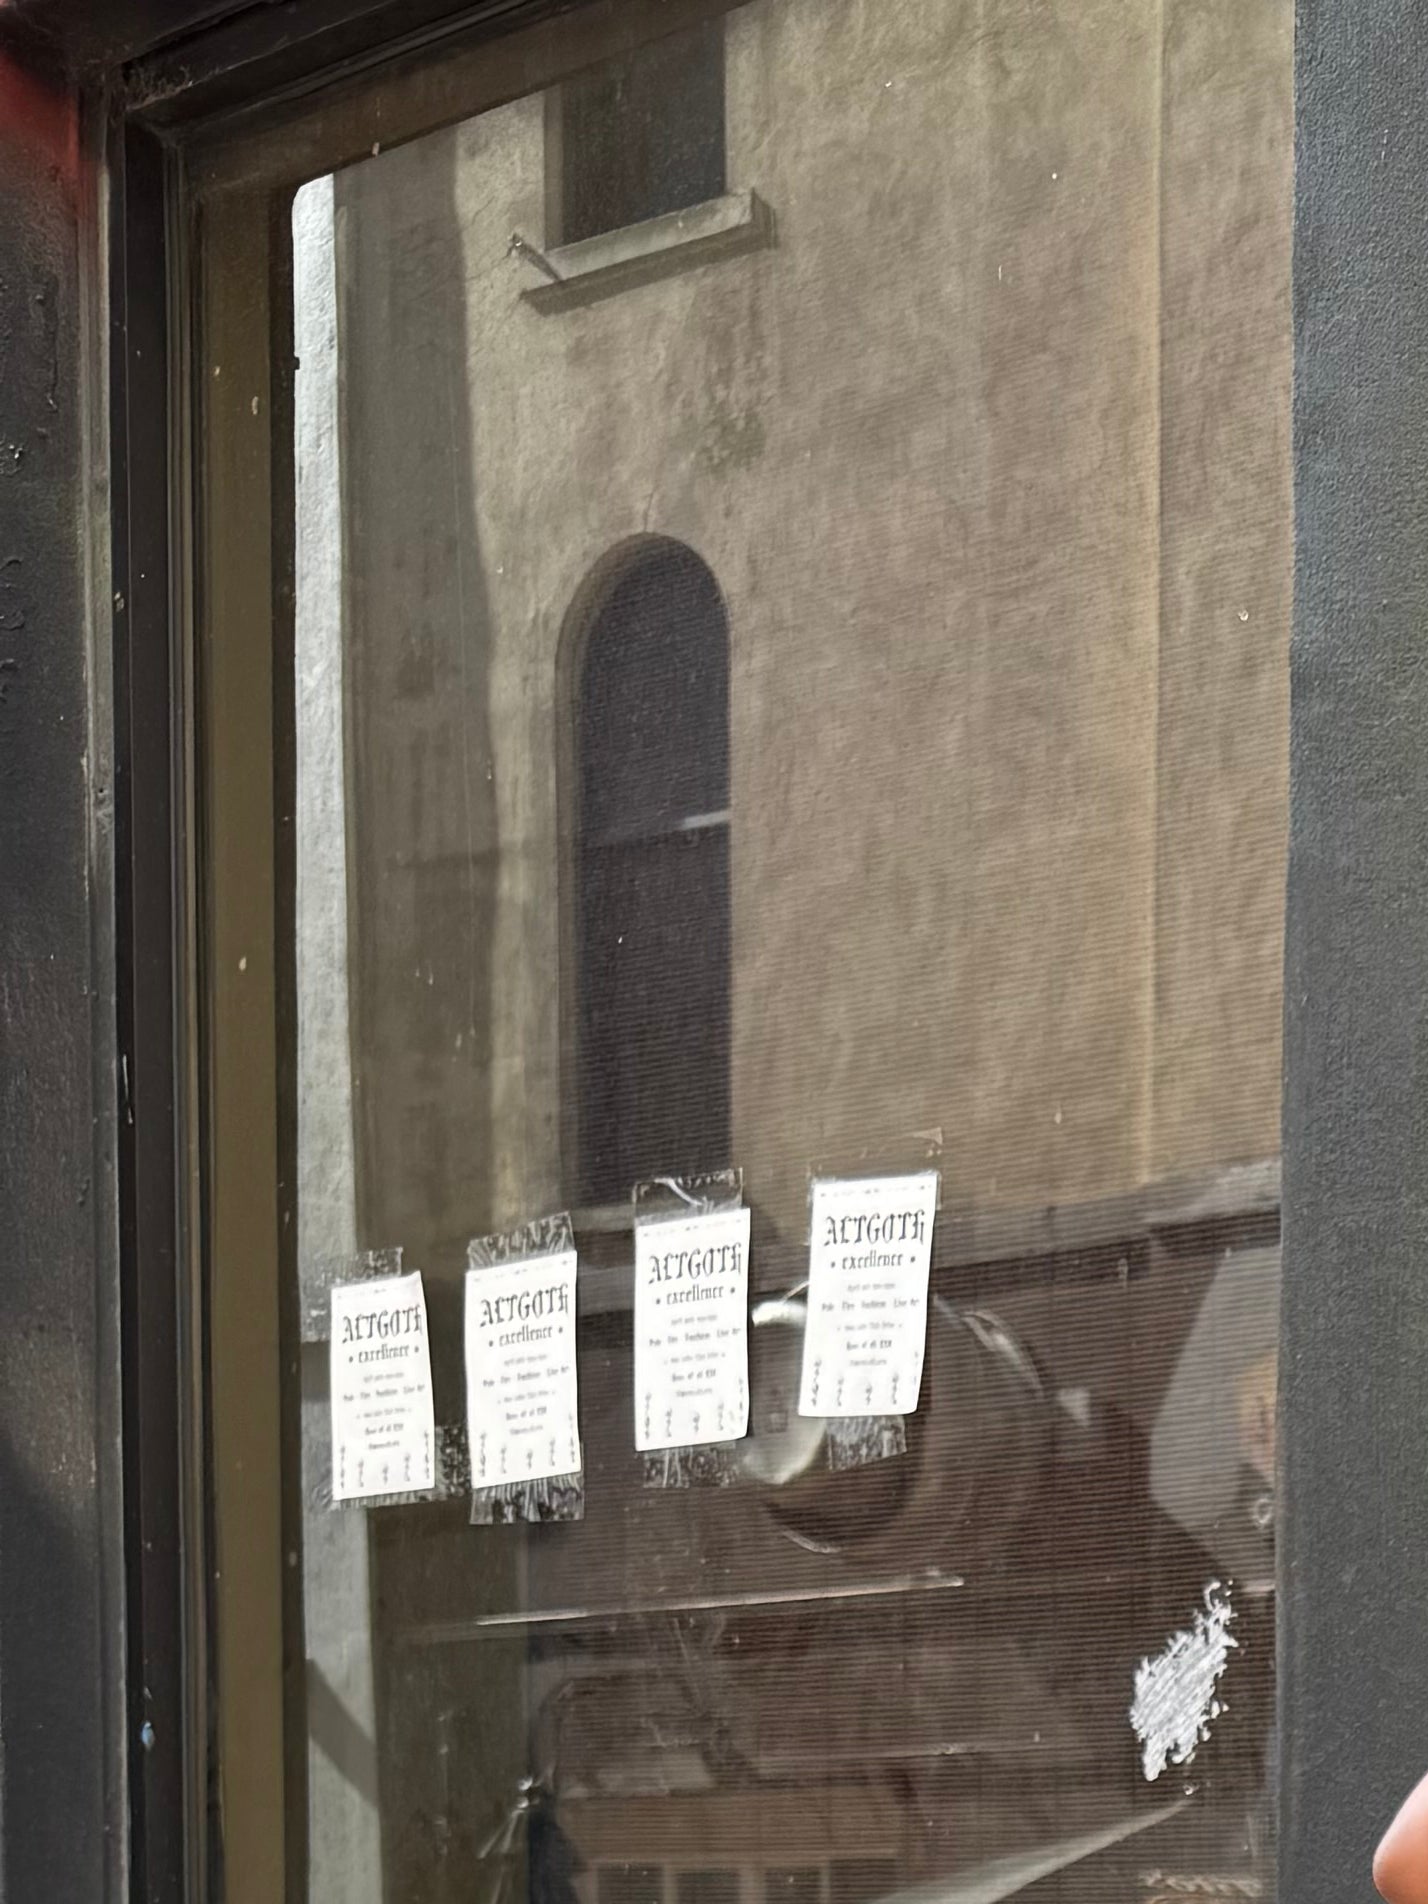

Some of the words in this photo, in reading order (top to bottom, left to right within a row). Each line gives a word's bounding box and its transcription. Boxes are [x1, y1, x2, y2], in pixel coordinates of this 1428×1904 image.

[841, 1250, 904, 1270] excellence
[666, 1284, 725, 1306] excellence
[498, 1325, 554, 1347] excellence
[358, 1344, 411, 1363] excellence
